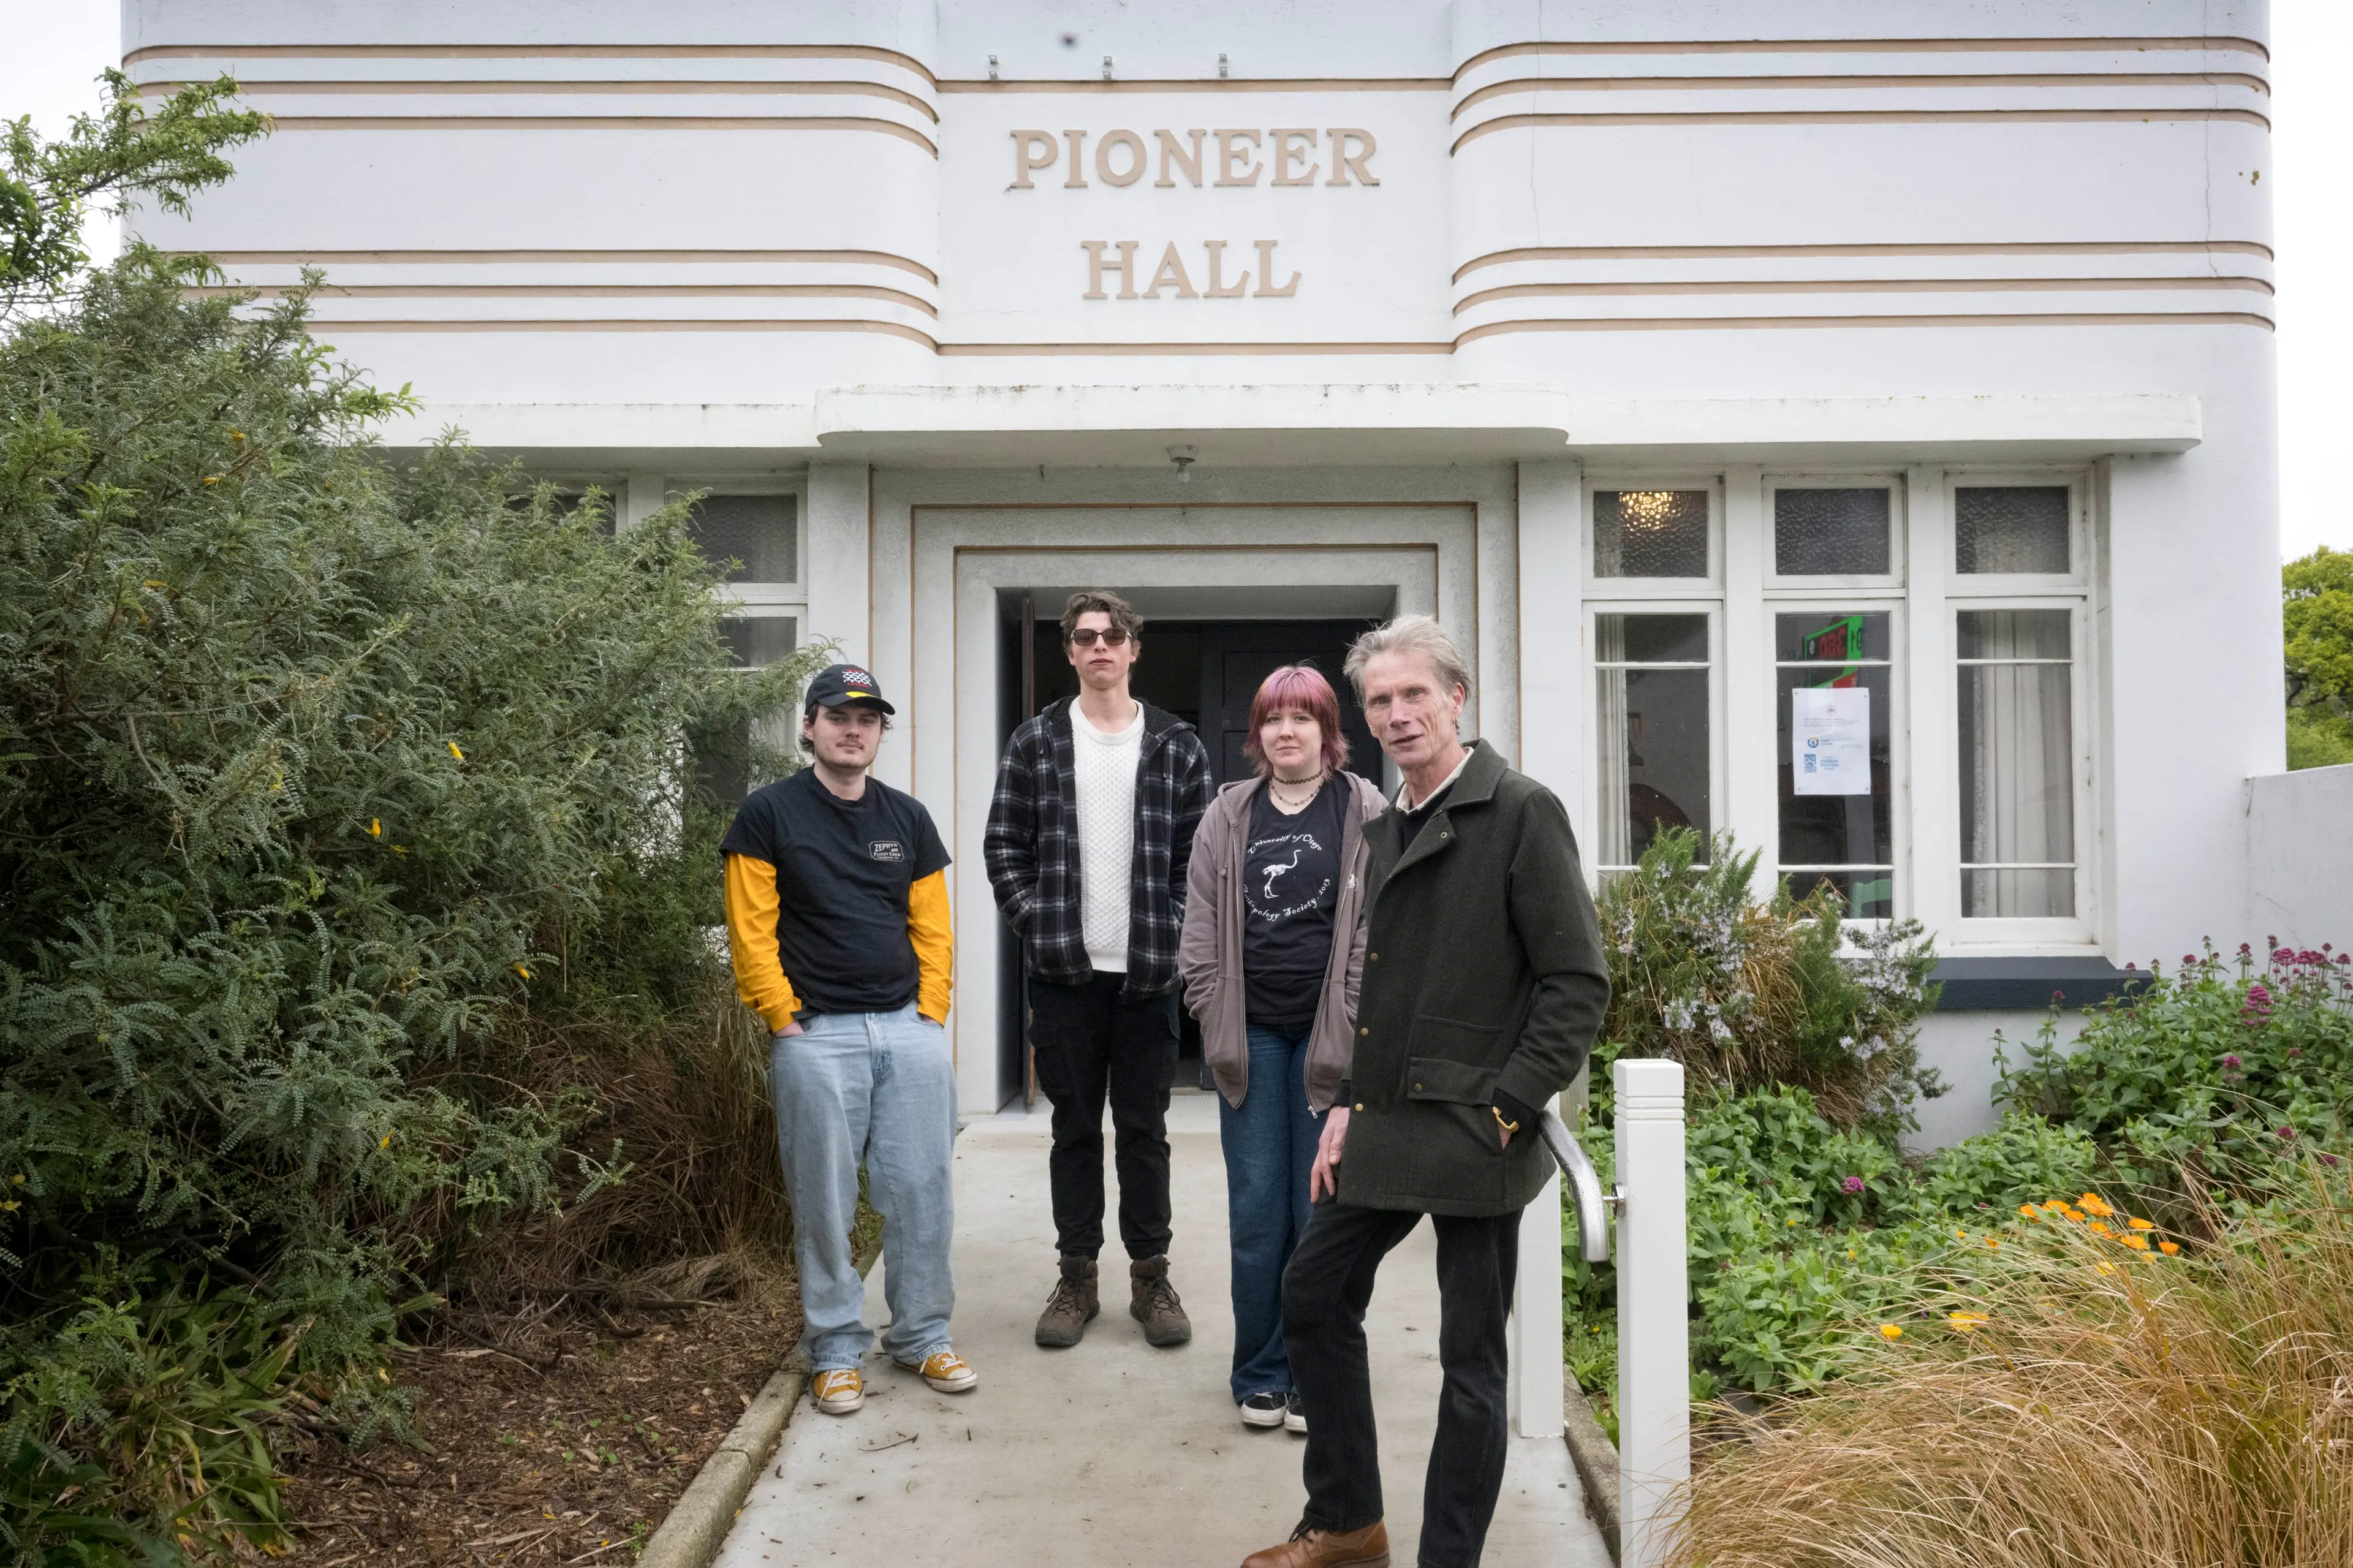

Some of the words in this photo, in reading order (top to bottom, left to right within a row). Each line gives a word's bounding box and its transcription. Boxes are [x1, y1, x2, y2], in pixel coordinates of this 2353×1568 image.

[1010, 128, 1380, 189] PIONEER
[1080, 240, 1302, 299] HALL
[1248, 834, 1291, 854] University
[1292, 834, 1304, 843] of
[1303, 834, 1322, 850] Otago
[1283, 898, 1317, 917] Society
[1318, 878, 1330, 895] 2013
